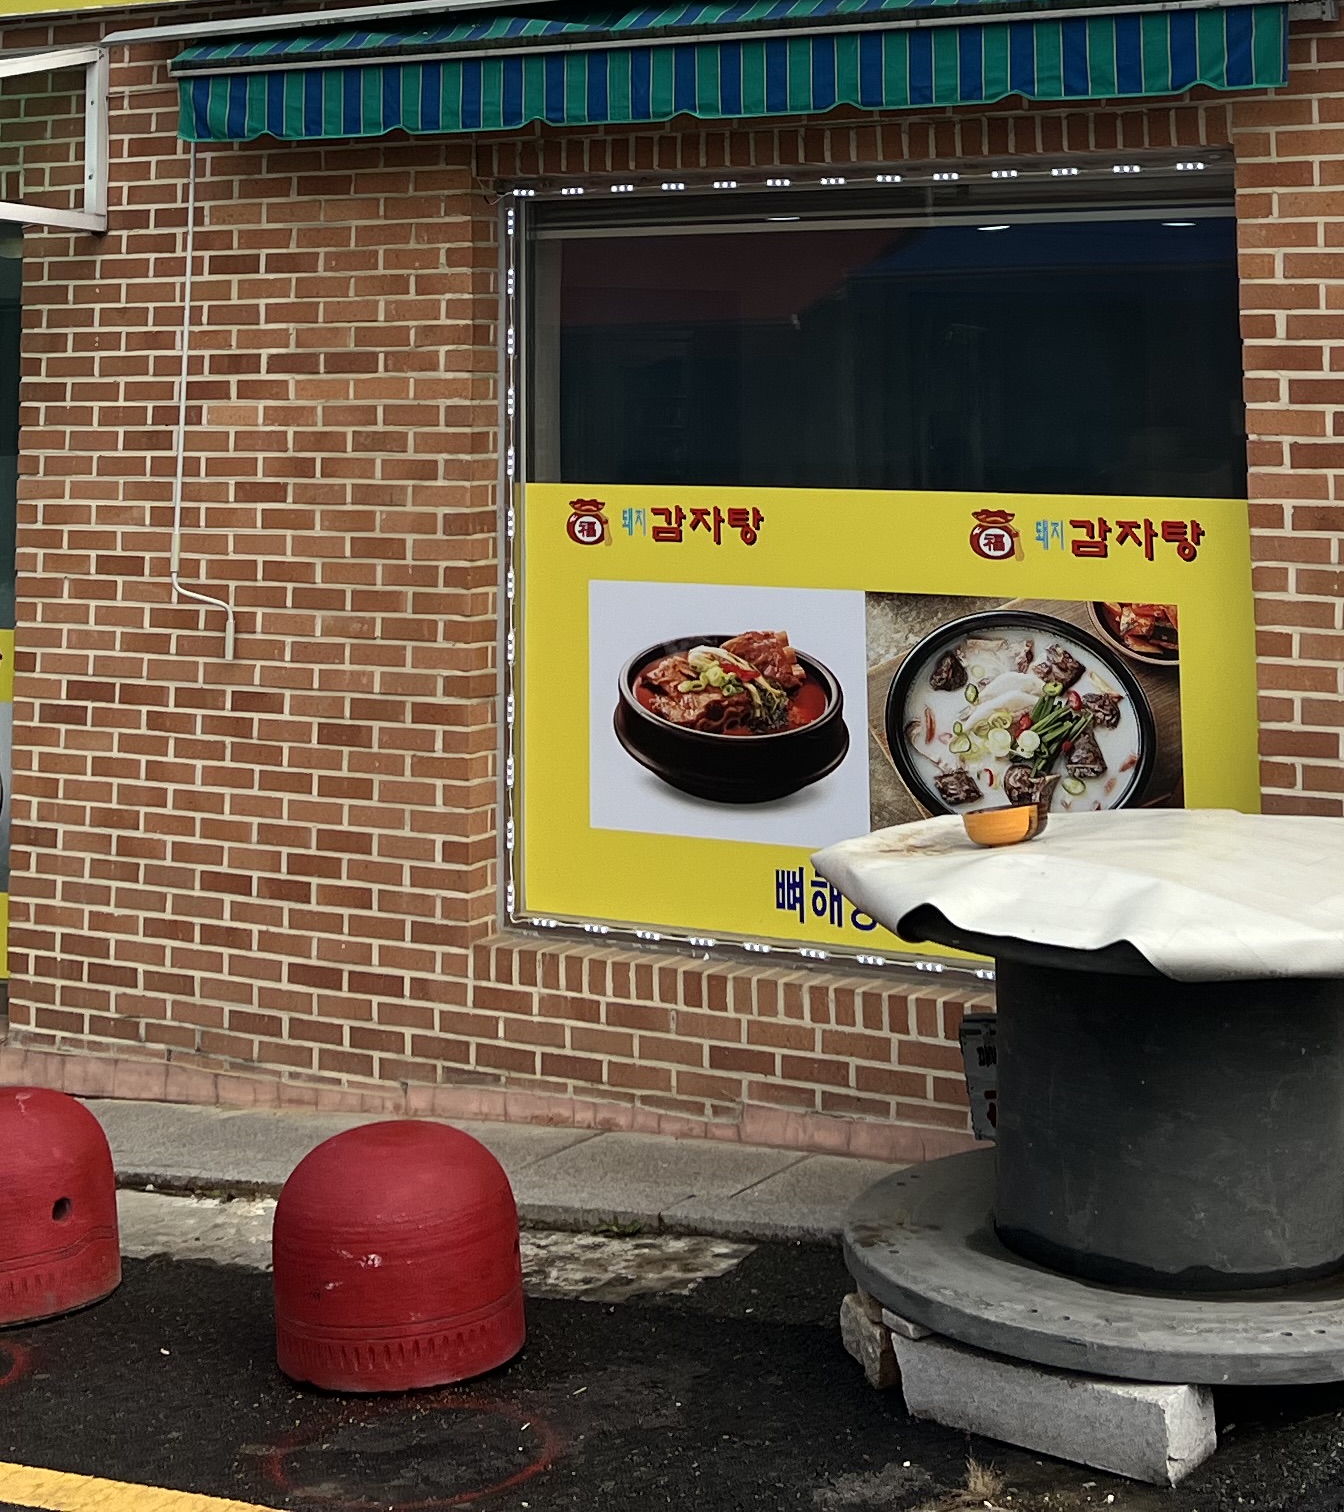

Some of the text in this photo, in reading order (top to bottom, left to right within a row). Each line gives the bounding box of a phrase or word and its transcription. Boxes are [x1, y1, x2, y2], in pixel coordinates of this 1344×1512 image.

[621, 504, 765, 546] 돼지 감자탕
[1035, 517, 1206, 562] 돼지 감자탕
